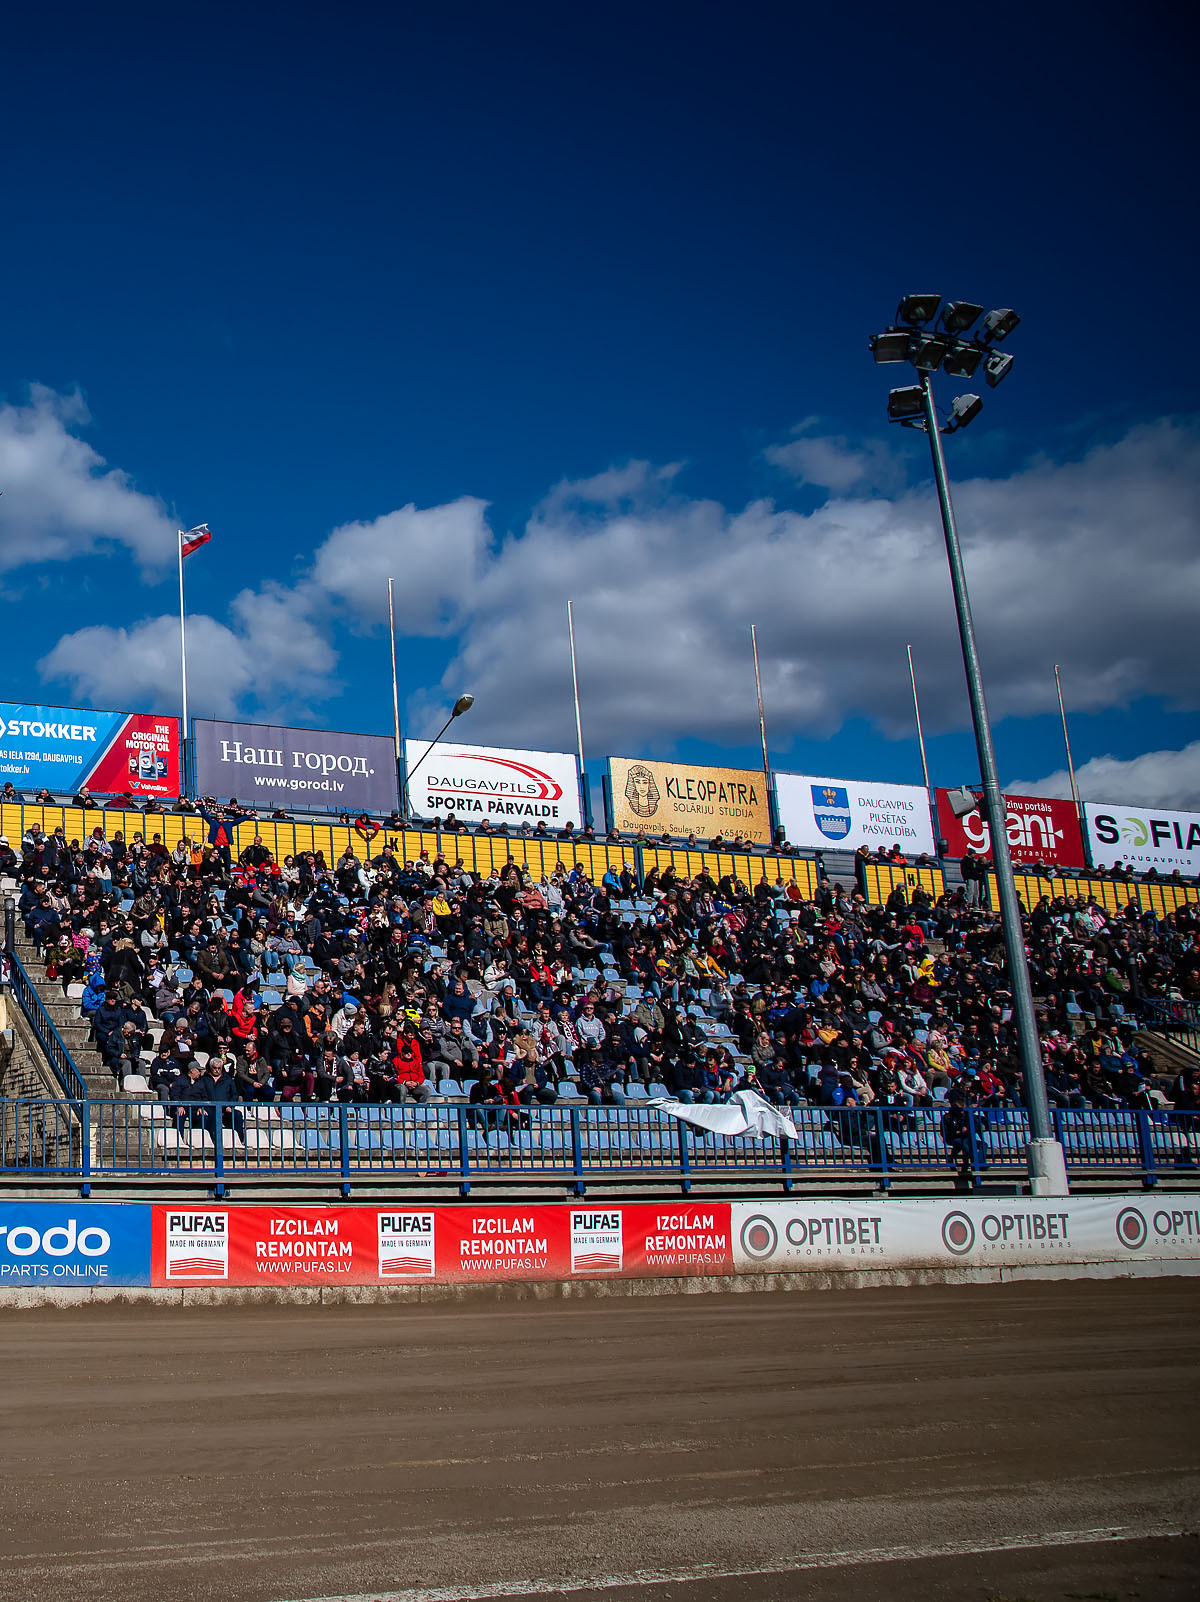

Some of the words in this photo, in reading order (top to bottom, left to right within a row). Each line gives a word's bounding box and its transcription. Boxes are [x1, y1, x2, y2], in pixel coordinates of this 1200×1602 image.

[6, 720, 96, 742] STOKKER
[131, 732, 169, 743] ORIGINAL
[155, 725, 169, 734] THE
[126, 740, 155, 750] MOTOR
[157, 743, 170, 752] OIL
[9, 751, 24, 761] IELA
[42, 754, 83, 765] DAUGAVPILS
[220, 740, 283, 767] Наш
[292, 751, 375, 778] город.
[254, 776, 344, 792] www.gorod.lv
[427, 776, 536, 794] DAUGAVPILS
[665, 776, 758, 806] KLEOPATRA
[427, 796, 483, 812] SPORTA
[488, 799, 559, 817] PĀRVALDE
[673, 802, 714, 815] SOLĀRIJU
[719, 806, 754, 818] STUDIJA
[858, 797, 914, 811] DAUGAVPILS
[1025, 802, 1052, 812] portāls
[869, 811, 907, 824] PILSĒTAS
[623, 820, 667, 833] Daugavpils,
[669, 823, 705, 835] Saules-37
[724, 829, 763, 840] 65426177
[862, 823, 917, 837] PAŠVALDĪBA
[962, 811, 1056, 854] gani
[1123, 854, 1193, 865] DAUGAVPILS
[169, 1215, 225, 1232] PUFAS
[270, 1219, 339, 1236] IZCILAM
[381, 1216, 431, 1232] PUFAS
[472, 1218, 534, 1234] IZCILAM
[573, 1214, 620, 1230] PUFAS
[656, 1215, 714, 1231] IZCILAM
[981, 1214, 1069, 1241] OPTIBET
[786, 1217, 881, 1246] OPTIBET
[196, 1240, 225, 1248] GERMANY
[405, 1240, 432, 1248] GERMANY
[460, 1239, 547, 1255] REMONTAM
[573, 1236, 587, 1244] MADE
[595, 1236, 619, 1244] GERMANY
[645, 1235, 726, 1251] REMONTAM
[256, 1241, 353, 1257] REMONTAM
[786, 1247, 841, 1256] SPORTA
[850, 1246, 884, 1254] BĀRS
[256, 1261, 352, 1273] WWW.PUFAS.LV
[460, 1258, 547, 1270] WWW.PUFAS.LV
[646, 1253, 726, 1265] WWW.PUFAS.LV
[0, 1264, 49, 1276] PARTS
[52, 1264, 108, 1277] ONLINE
